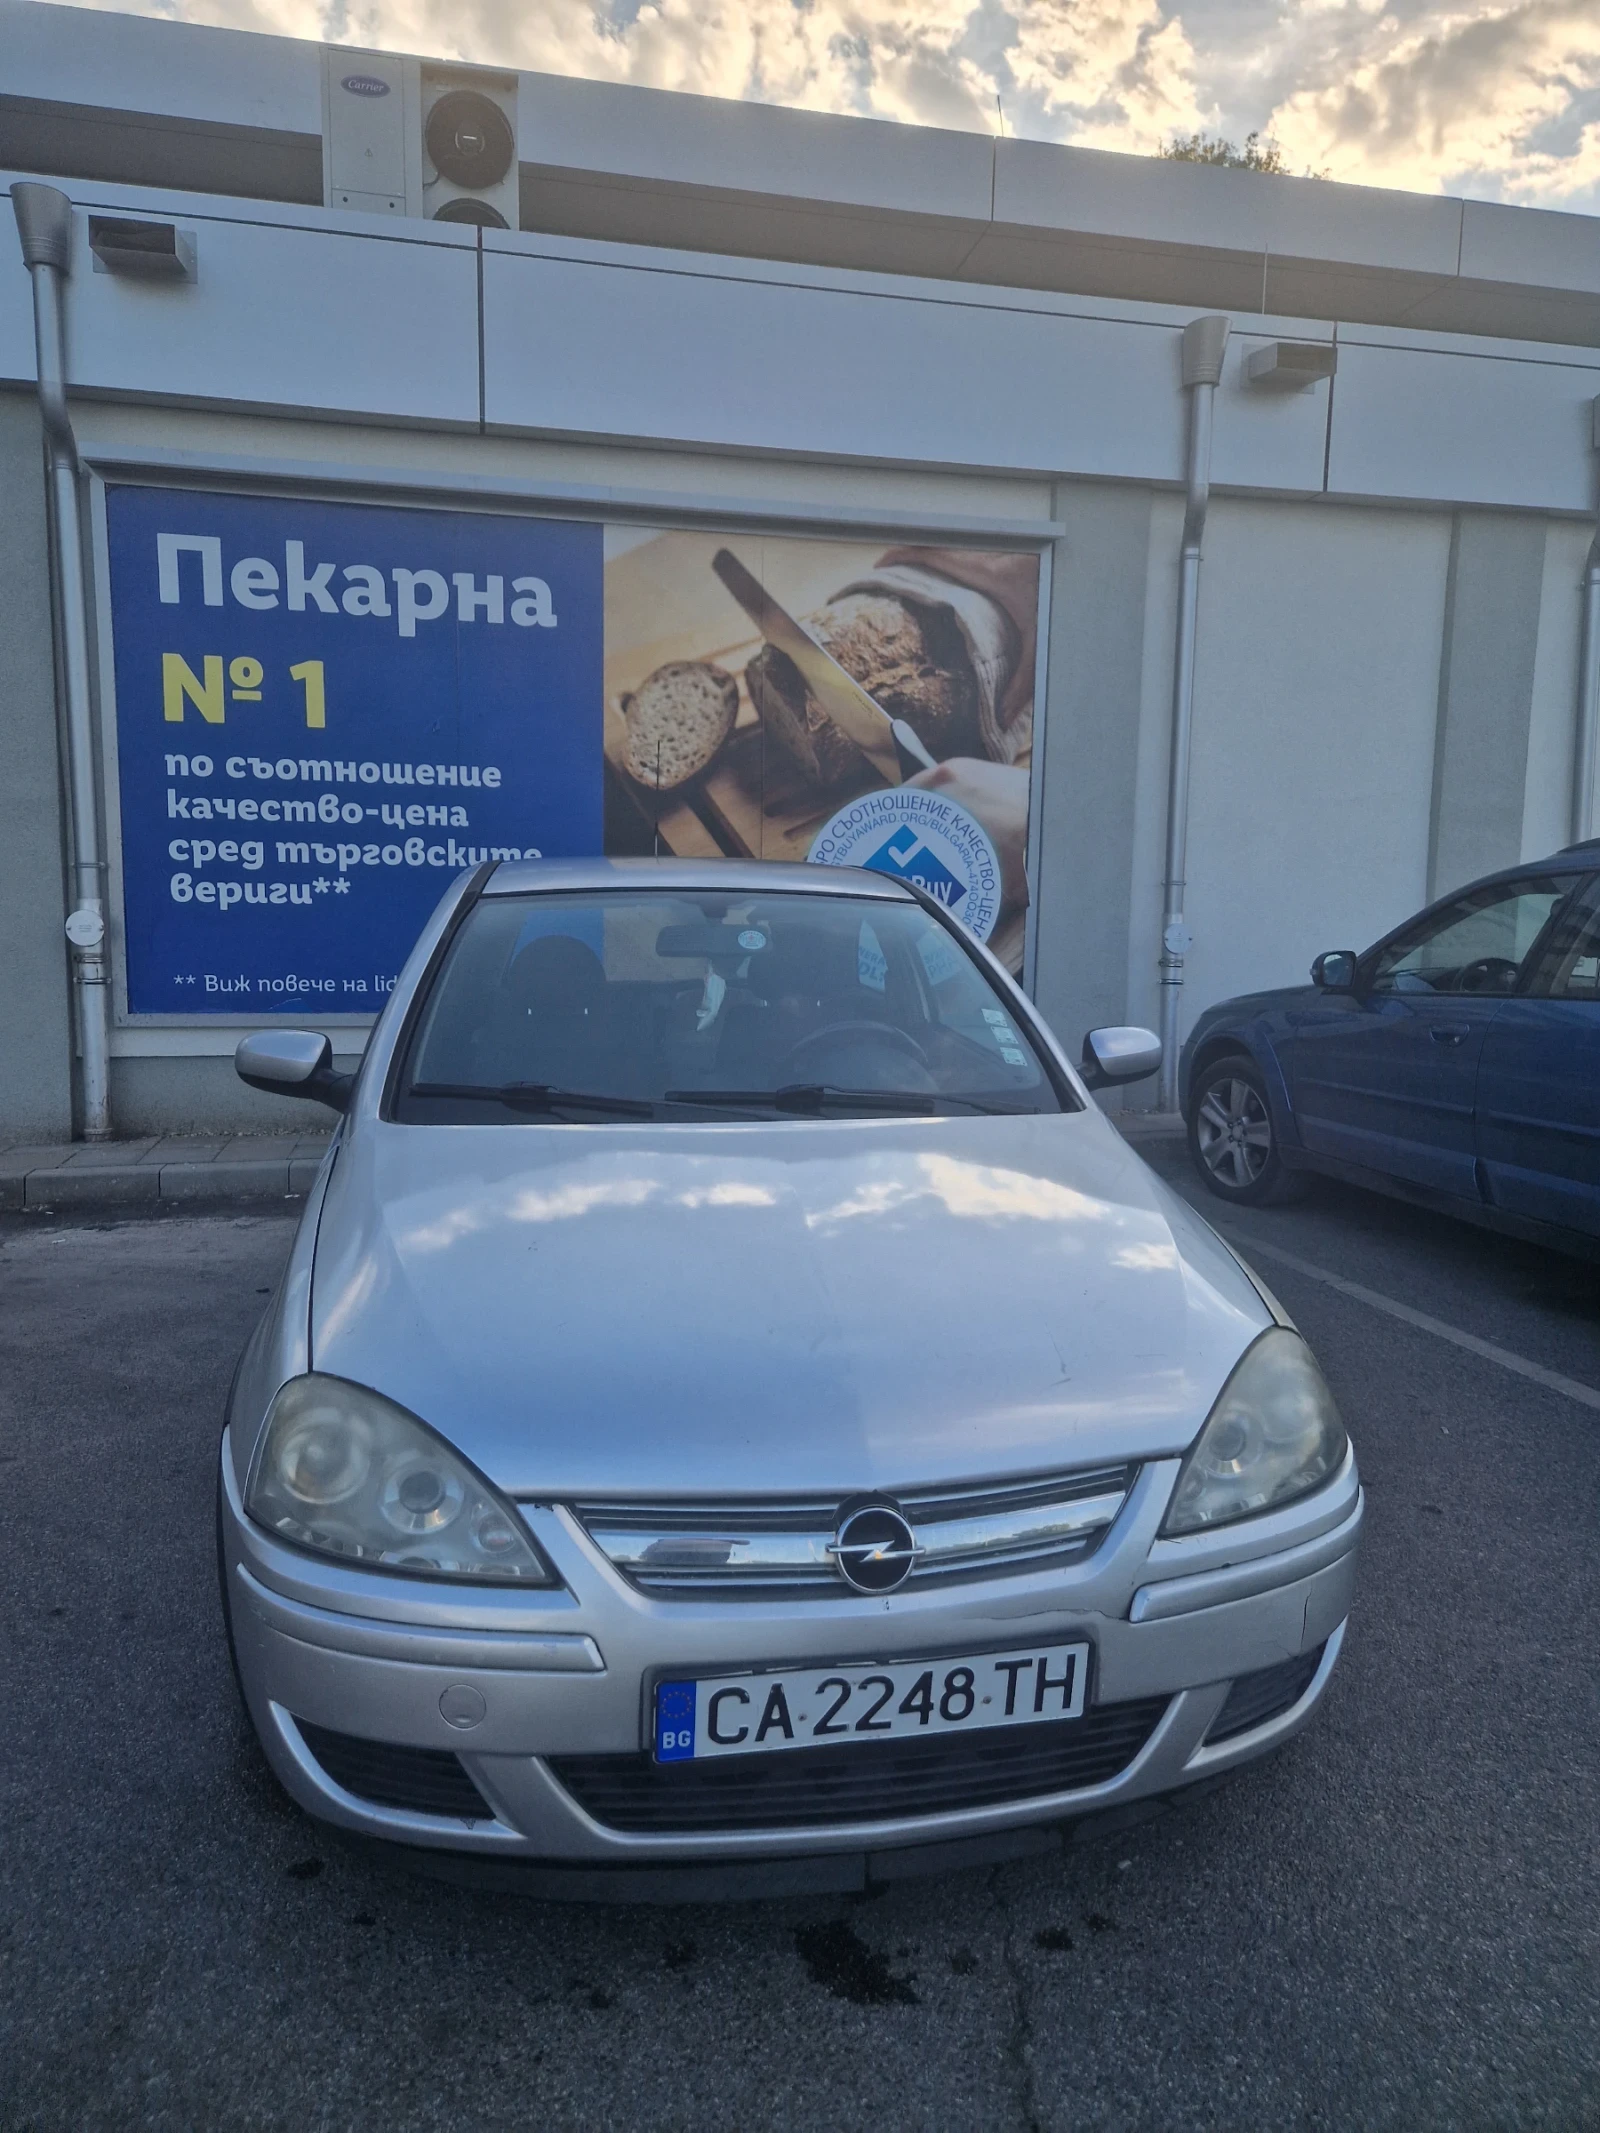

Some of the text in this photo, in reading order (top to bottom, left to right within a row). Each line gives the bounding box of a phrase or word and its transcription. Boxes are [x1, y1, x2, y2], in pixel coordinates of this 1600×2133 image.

[349, 80, 384, 92] Carrier
[156, 532, 558, 637] Пекарна
[289, 660, 326, 728] 1
[165, 753, 502, 788] по съотношение
[167, 788, 469, 830] качество-цена
[814, 838, 835, 863] РО
[831, 794, 953, 839] СЪОТНОШЕНИЕ
[168, 837, 542, 871] сред търговските
[203, 974, 251, 992] Виж
[257, 974, 336, 992] повече
[342, 978, 368, 992] на
[662, 1653, 1077, 1750] BG CA 2248 TH
